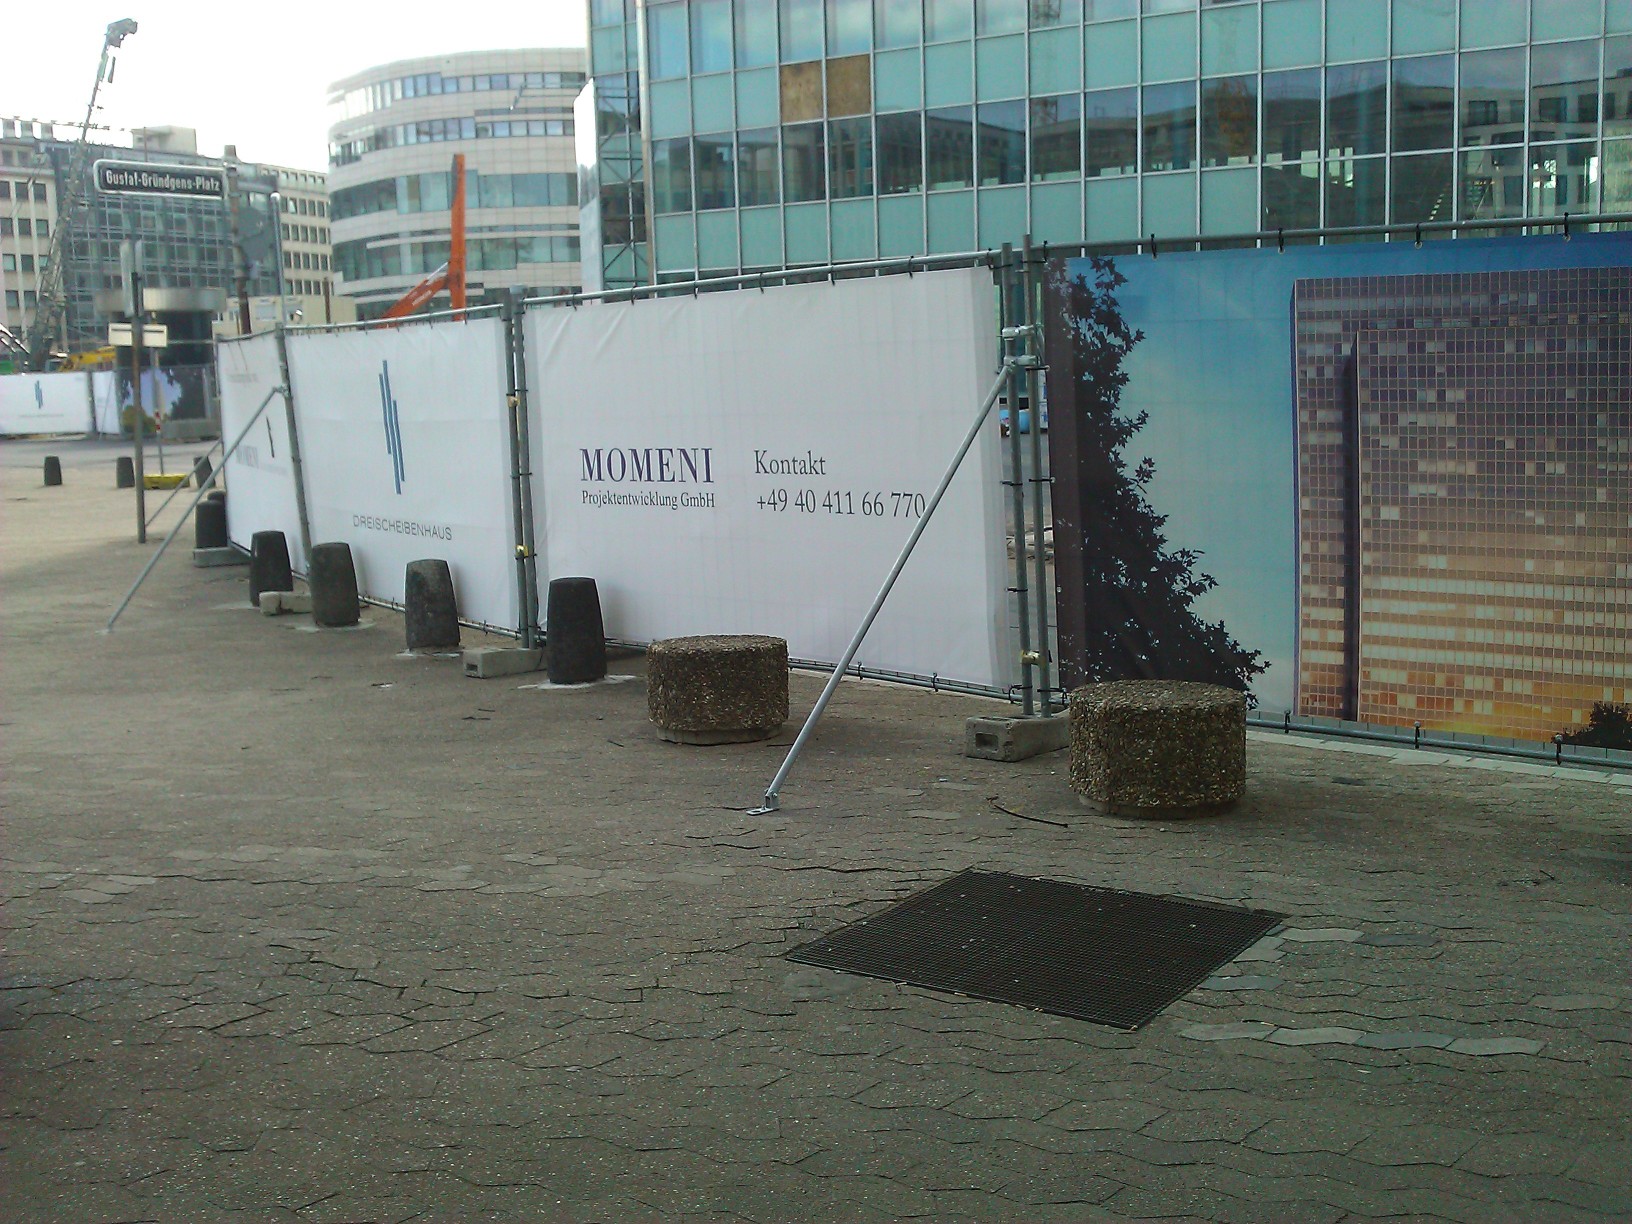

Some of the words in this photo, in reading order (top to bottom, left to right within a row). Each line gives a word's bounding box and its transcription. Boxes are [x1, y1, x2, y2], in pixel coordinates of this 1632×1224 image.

[580, 448, 714, 483] MOMENI
[754, 450, 826, 476] Kontakt
[582, 490, 679, 510] Projektentwicklung
[680, 492, 715, 508] GmbH
[757, 488, 788, 512] +49
[794, 489, 816, 513] 40
[821, 490, 855, 515] 411
[861, 491, 884, 517] 66
[890, 492, 925, 518] 770
[353, 515, 452, 541] DREISCHEIBENHAUS
